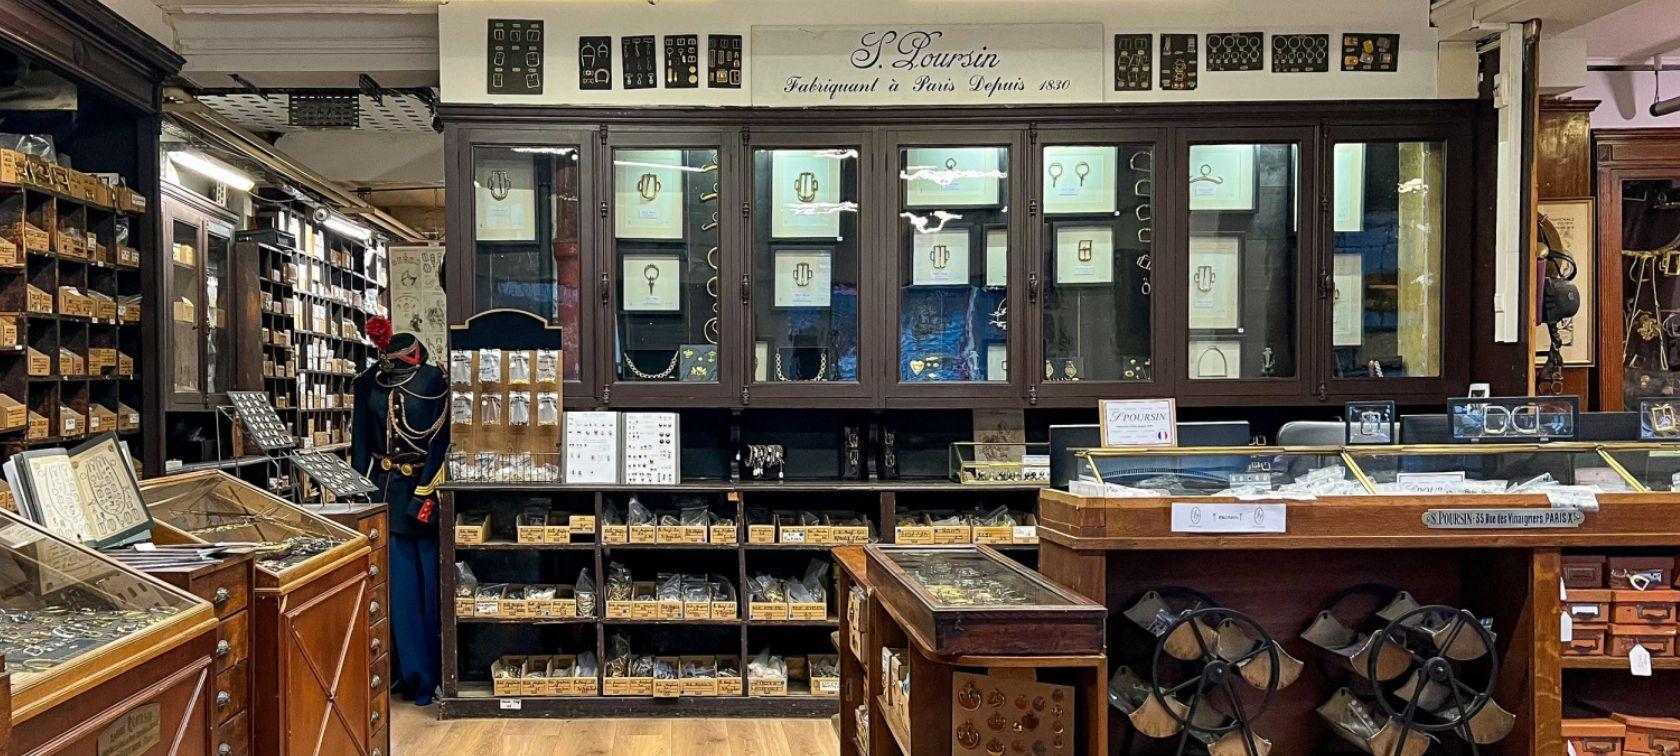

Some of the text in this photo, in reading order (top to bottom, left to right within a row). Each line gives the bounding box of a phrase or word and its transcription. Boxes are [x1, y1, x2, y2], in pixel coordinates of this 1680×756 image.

[892, 30, 1001, 70] Poursin
[784, 75, 1071, 99] Fabriquant à Paris Depuis 1830
[1122, 412, 1167, 422] POURSIN
[1545, 512, 1567, 524] PARIS
